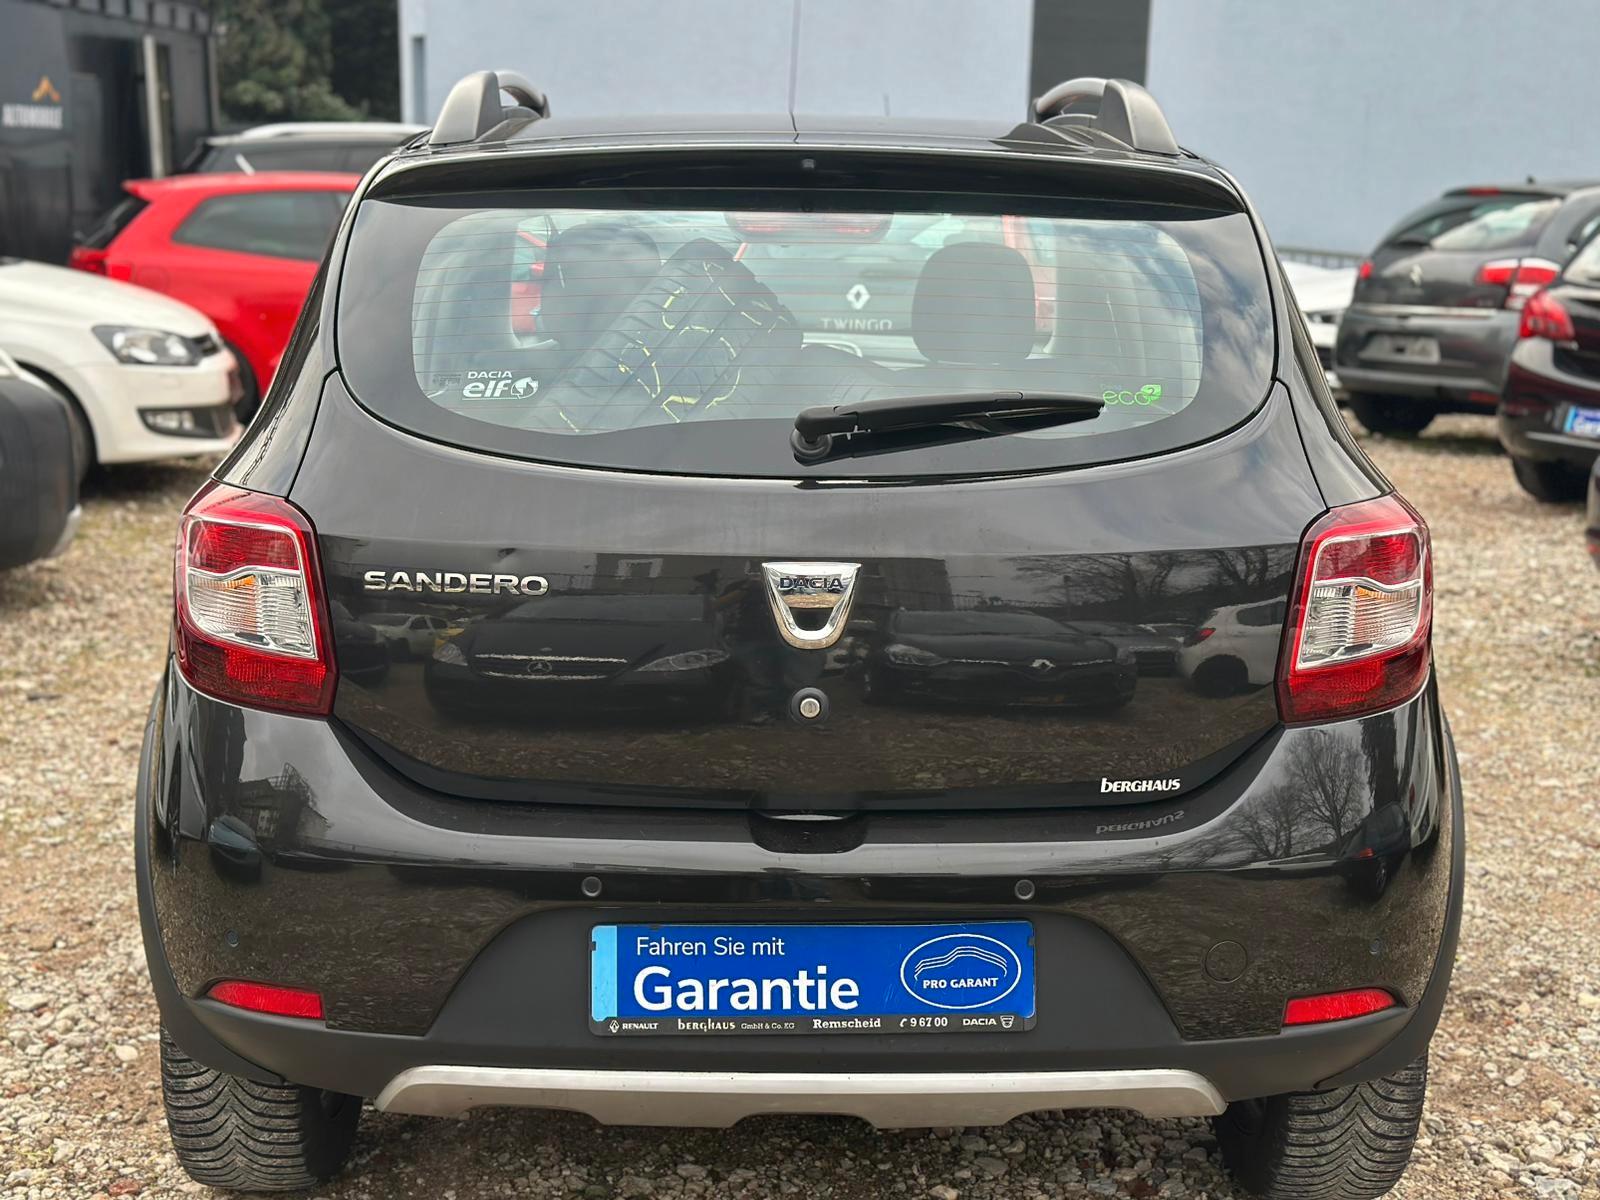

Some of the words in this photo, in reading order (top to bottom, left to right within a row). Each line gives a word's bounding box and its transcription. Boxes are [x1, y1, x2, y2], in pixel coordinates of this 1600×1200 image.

[819, 317, 894, 331] TWINGO
[467, 370, 513, 379] DACIA
[462, 379, 512, 398] elf
[363, 570, 549, 596] SANDERO
[779, 577, 844, 589] DACIA
[636, 936, 706, 956] Fahren
[713, 936, 745, 956] Sie
[752, 936, 785, 956] mit
[633, 964, 860, 1011] Garantie
[922, 979, 947, 990] PRO
[950, 977, 999, 989] GARANT
[622, 1022, 659, 1031] RENAULT
[741, 1022, 763, 1030] GmbH
[764, 1022, 770, 1030] &
[784, 1022, 795, 1030] KG
[812, 1018, 881, 1030] Remscheid
[962, 1018, 997, 1026] DACIA
